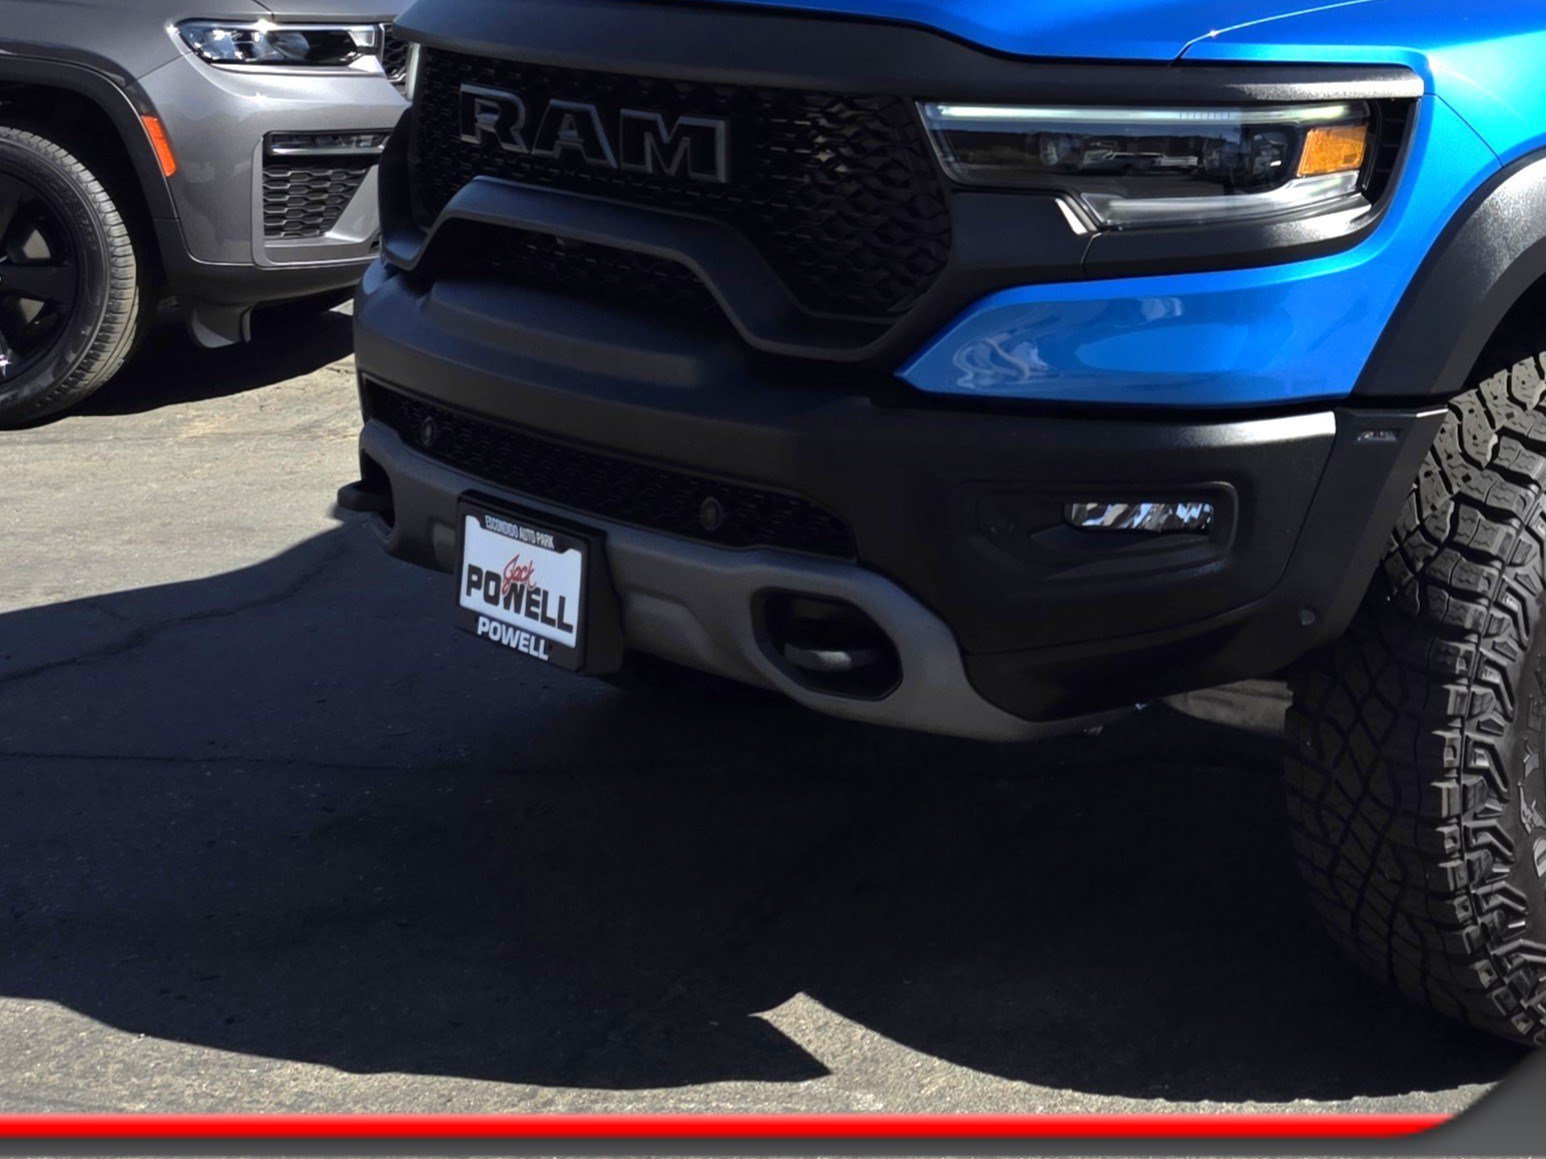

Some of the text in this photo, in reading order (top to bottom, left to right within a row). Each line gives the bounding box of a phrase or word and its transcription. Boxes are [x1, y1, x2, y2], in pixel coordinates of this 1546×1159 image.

[459, 83, 727, 184] RAM
[484, 514, 555, 550] ESCONDIDO AUTO PARK
[502, 553, 537, 597] Jack
[465, 562, 574, 635] POWELL
[476, 615, 550, 661] POWELL
